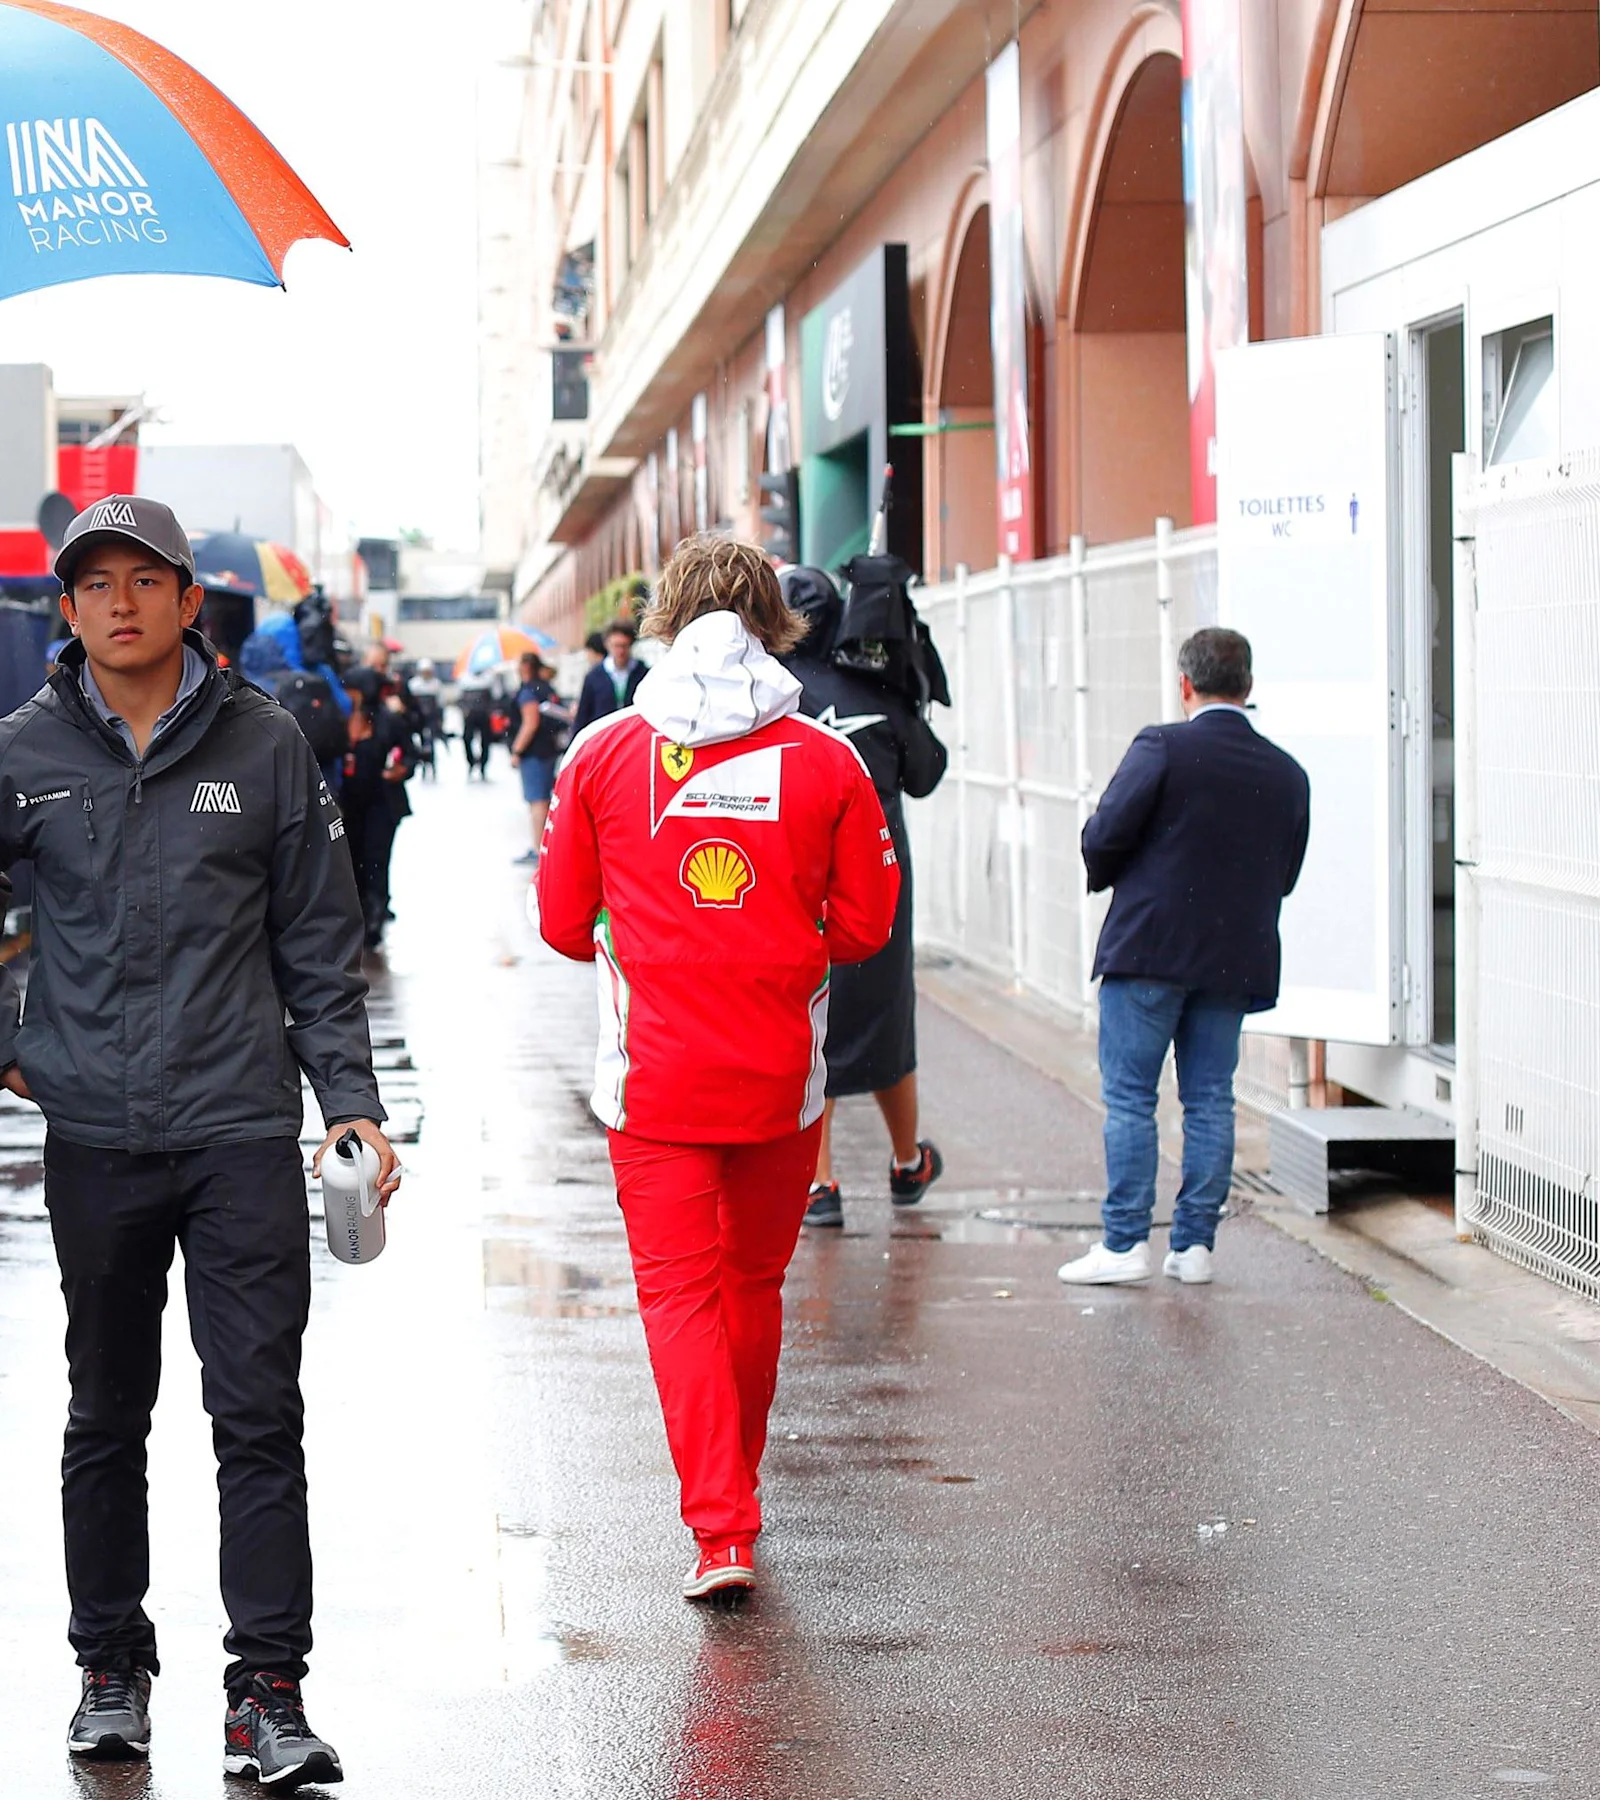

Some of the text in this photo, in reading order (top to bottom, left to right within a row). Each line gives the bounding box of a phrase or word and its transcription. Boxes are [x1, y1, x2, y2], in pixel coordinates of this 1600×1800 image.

[17, 191, 158, 226] MANOR
[29, 218, 168, 254] RACING
[1238, 494, 1325, 516] TOILETTES
[1272, 520, 1292, 537] WC
[685, 792, 752, 803] SCUDERIA
[709, 801, 768, 811] FERRARI
